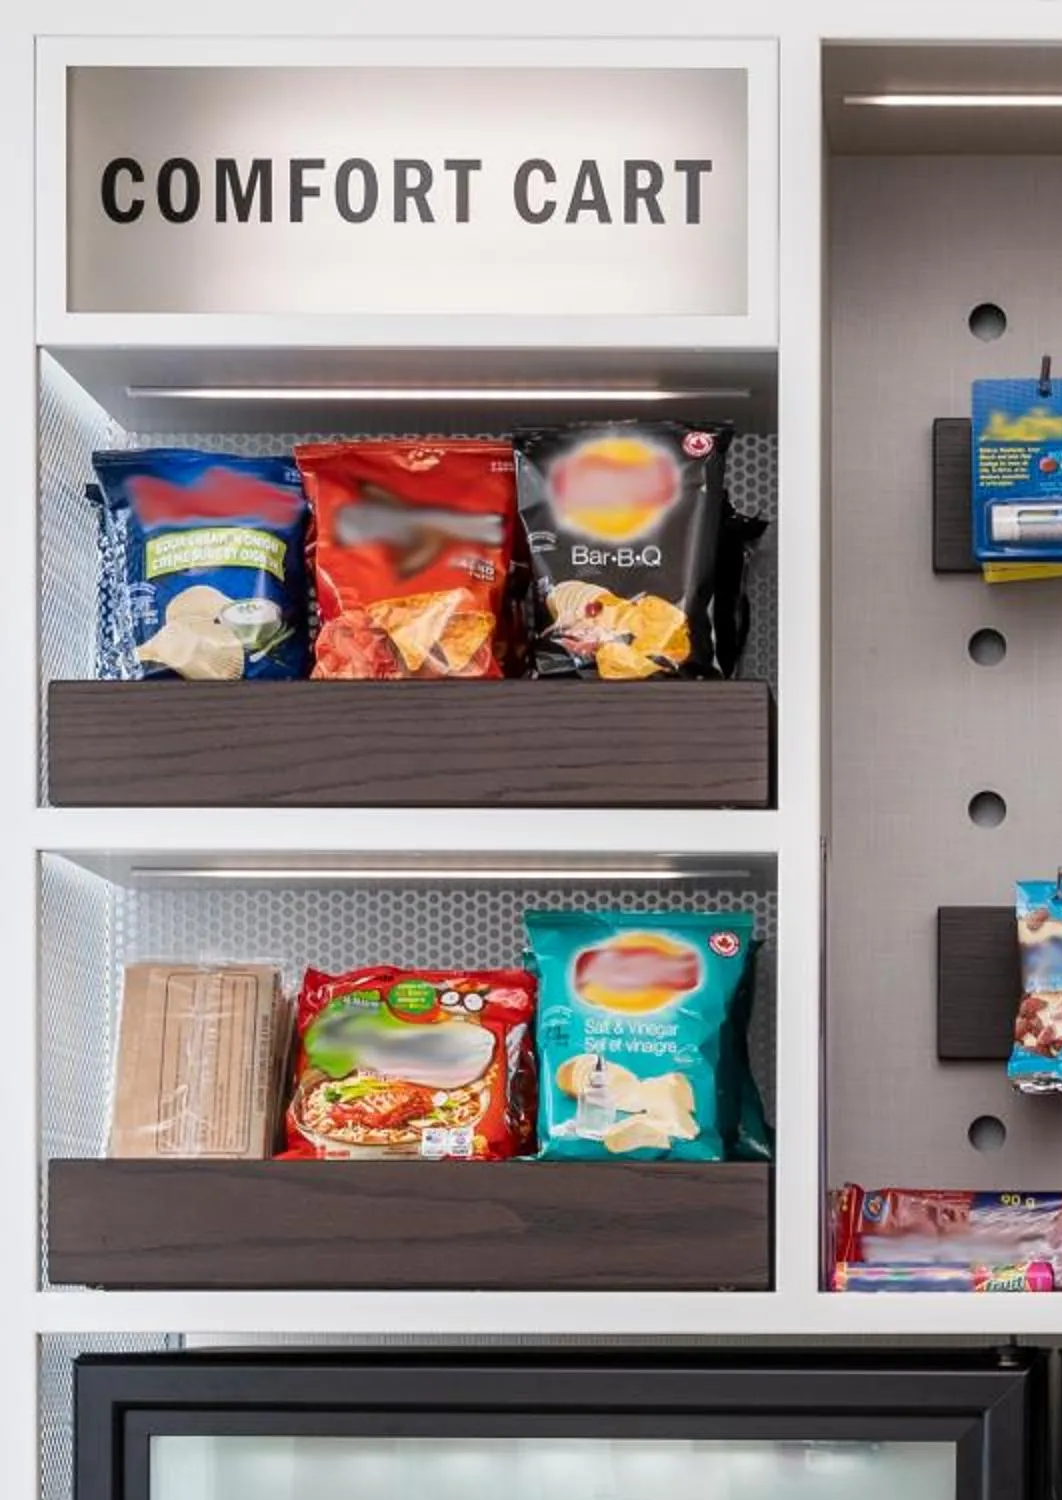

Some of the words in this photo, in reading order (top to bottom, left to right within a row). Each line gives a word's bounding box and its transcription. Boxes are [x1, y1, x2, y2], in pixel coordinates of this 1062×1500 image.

[101, 157, 482, 224] COMFORT
[513, 158, 713, 224] CART
[1001, 1193, 1020, 1206] 90
